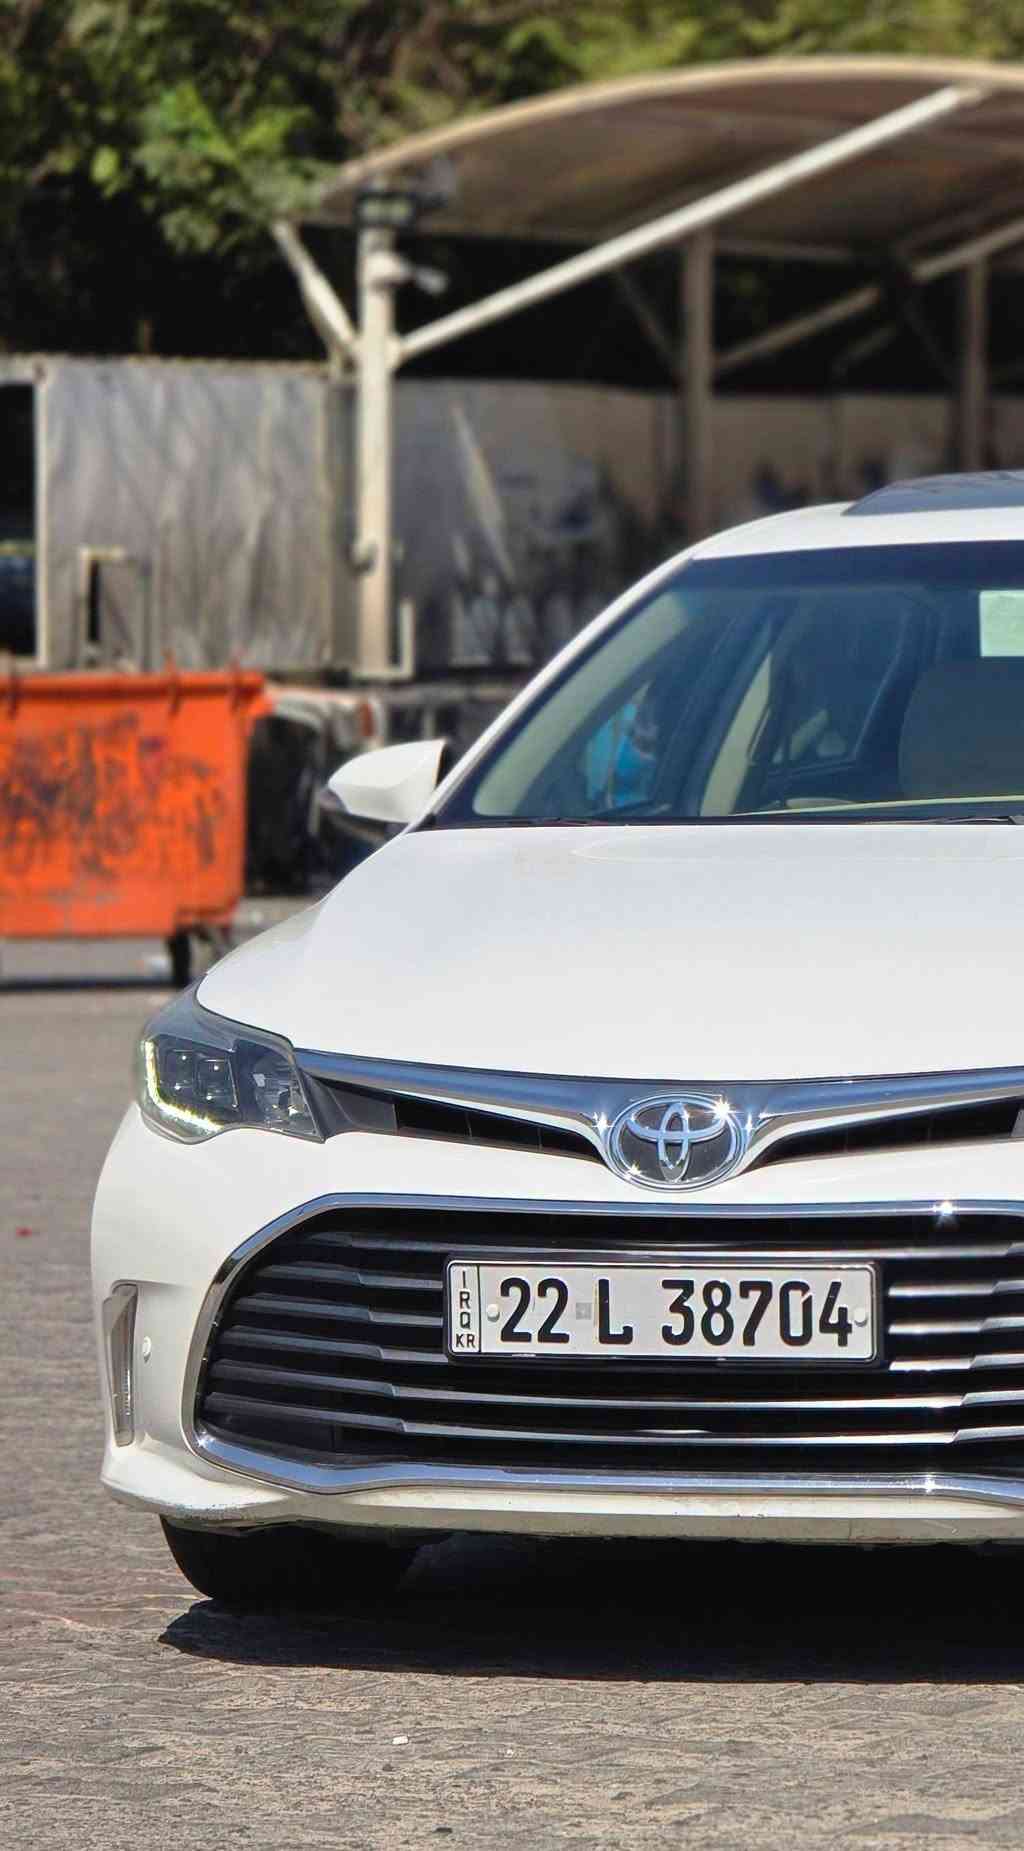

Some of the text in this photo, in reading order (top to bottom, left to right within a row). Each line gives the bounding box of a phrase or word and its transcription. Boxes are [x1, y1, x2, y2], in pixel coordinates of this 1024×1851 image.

[459, 1270, 471, 1330] IRQ
[500, 1277, 853, 1347] 22 L 38704
[455, 1333, 476, 1349] KR
